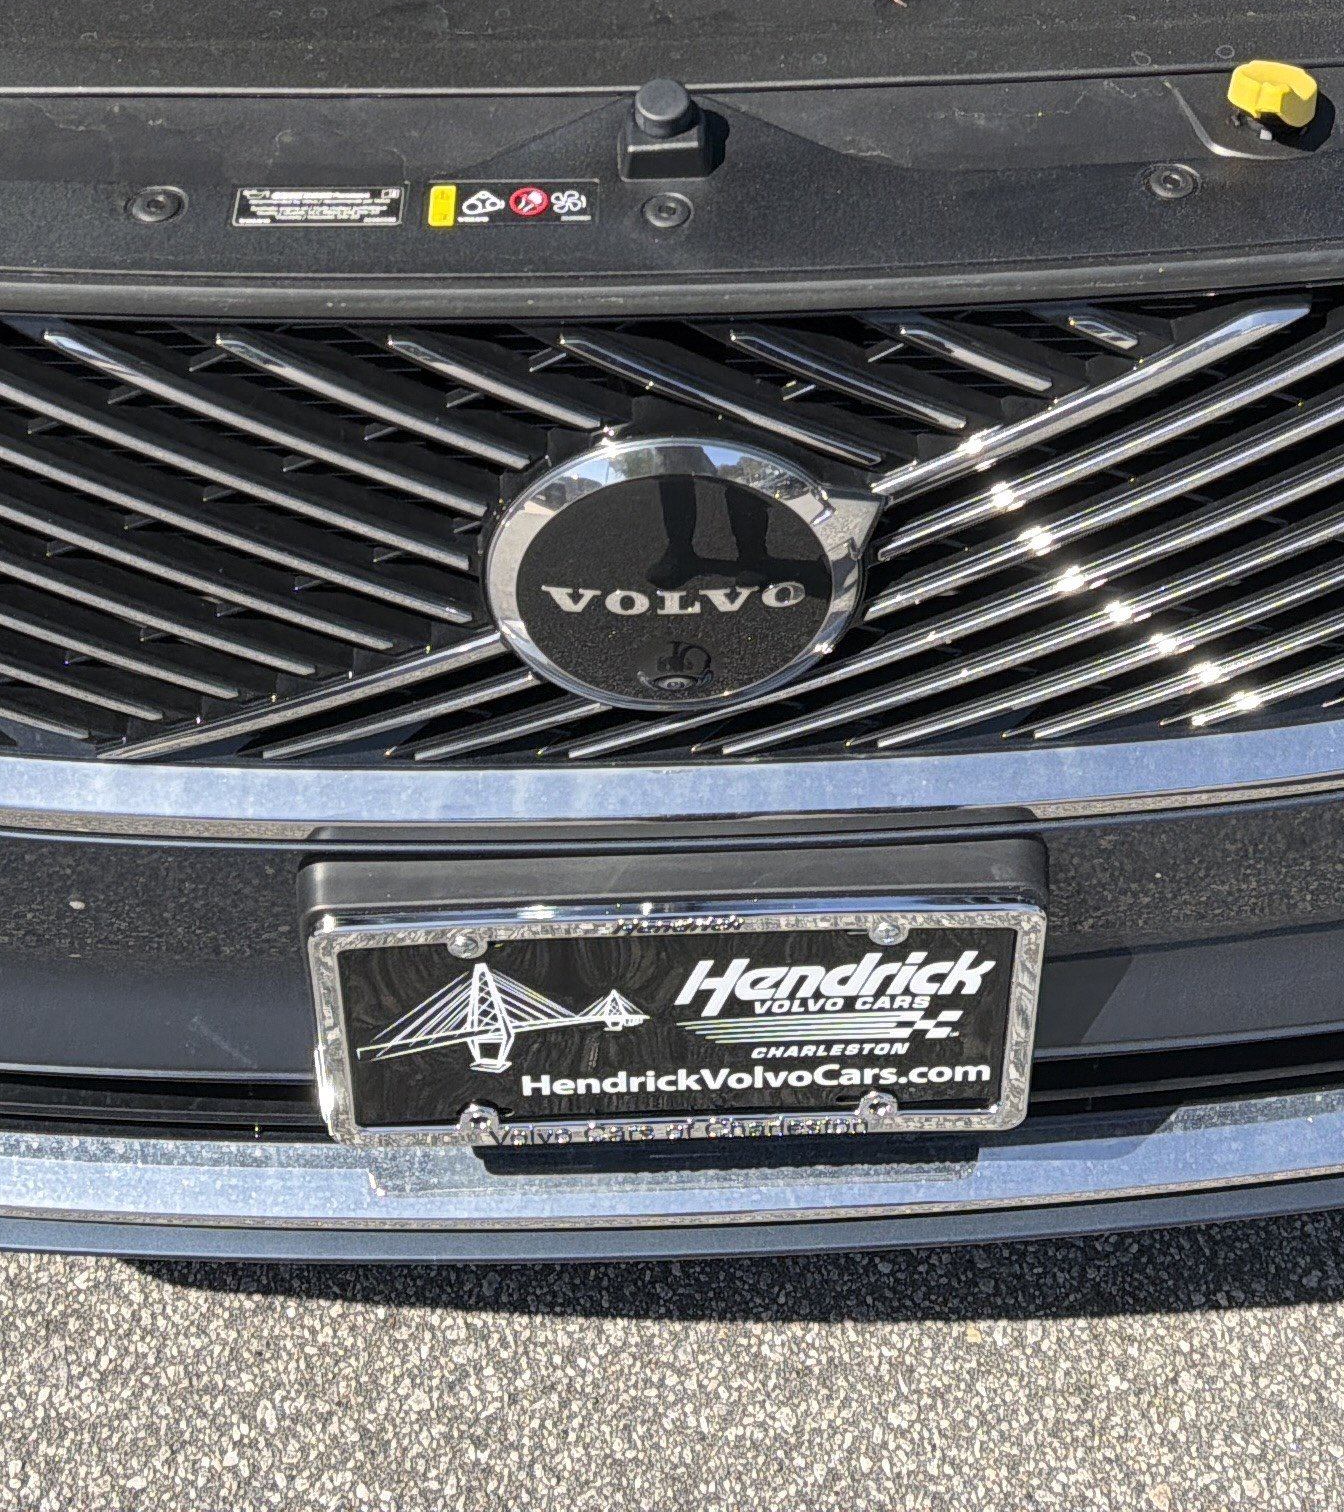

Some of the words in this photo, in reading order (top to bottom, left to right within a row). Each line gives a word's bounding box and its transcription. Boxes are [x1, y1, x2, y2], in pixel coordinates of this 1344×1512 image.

[540, 581, 806, 616] VOLVO
[673, 950, 997, 1017] Hendrick
[754, 998, 845, 1015] VOLVO
[854, 995, 931, 1011] CARS
[751, 1041, 910, 1059] CHARLESTON
[521, 1062, 992, 1097] HendrickVolvoCars.com
[489, 1123, 574, 1146] Volvo
[583, 1119, 655, 1143] Cars
[664, 1117, 696, 1140] of
[704, 1115, 869, 1138] Charleston
